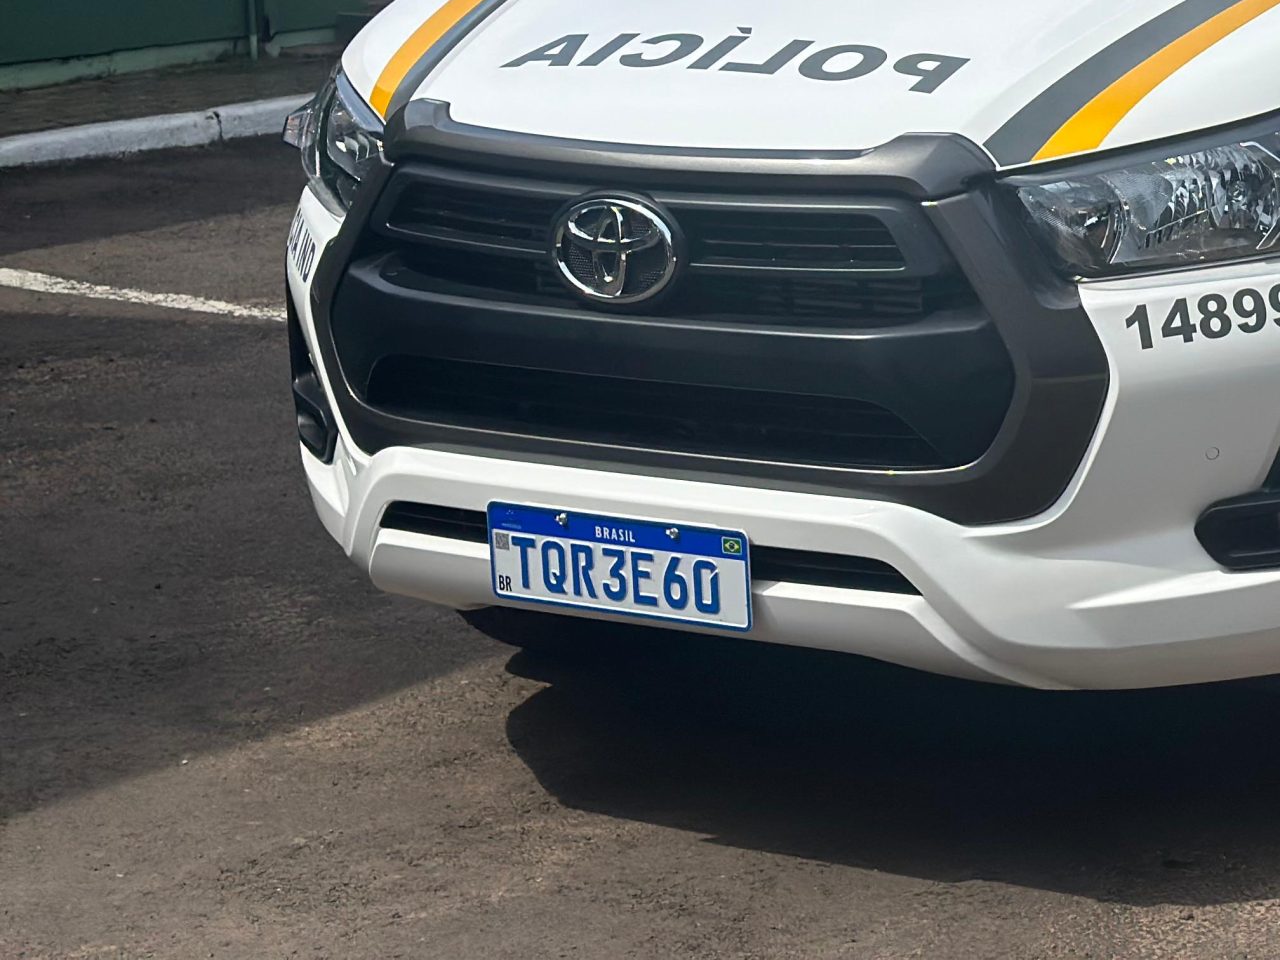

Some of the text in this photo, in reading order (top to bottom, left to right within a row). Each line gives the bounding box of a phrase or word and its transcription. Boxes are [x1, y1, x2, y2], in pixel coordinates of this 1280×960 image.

[595, 526, 636, 543] BRASIL
[498, 574, 512, 592] BR
[510, 535, 721, 615] TQR3E60
